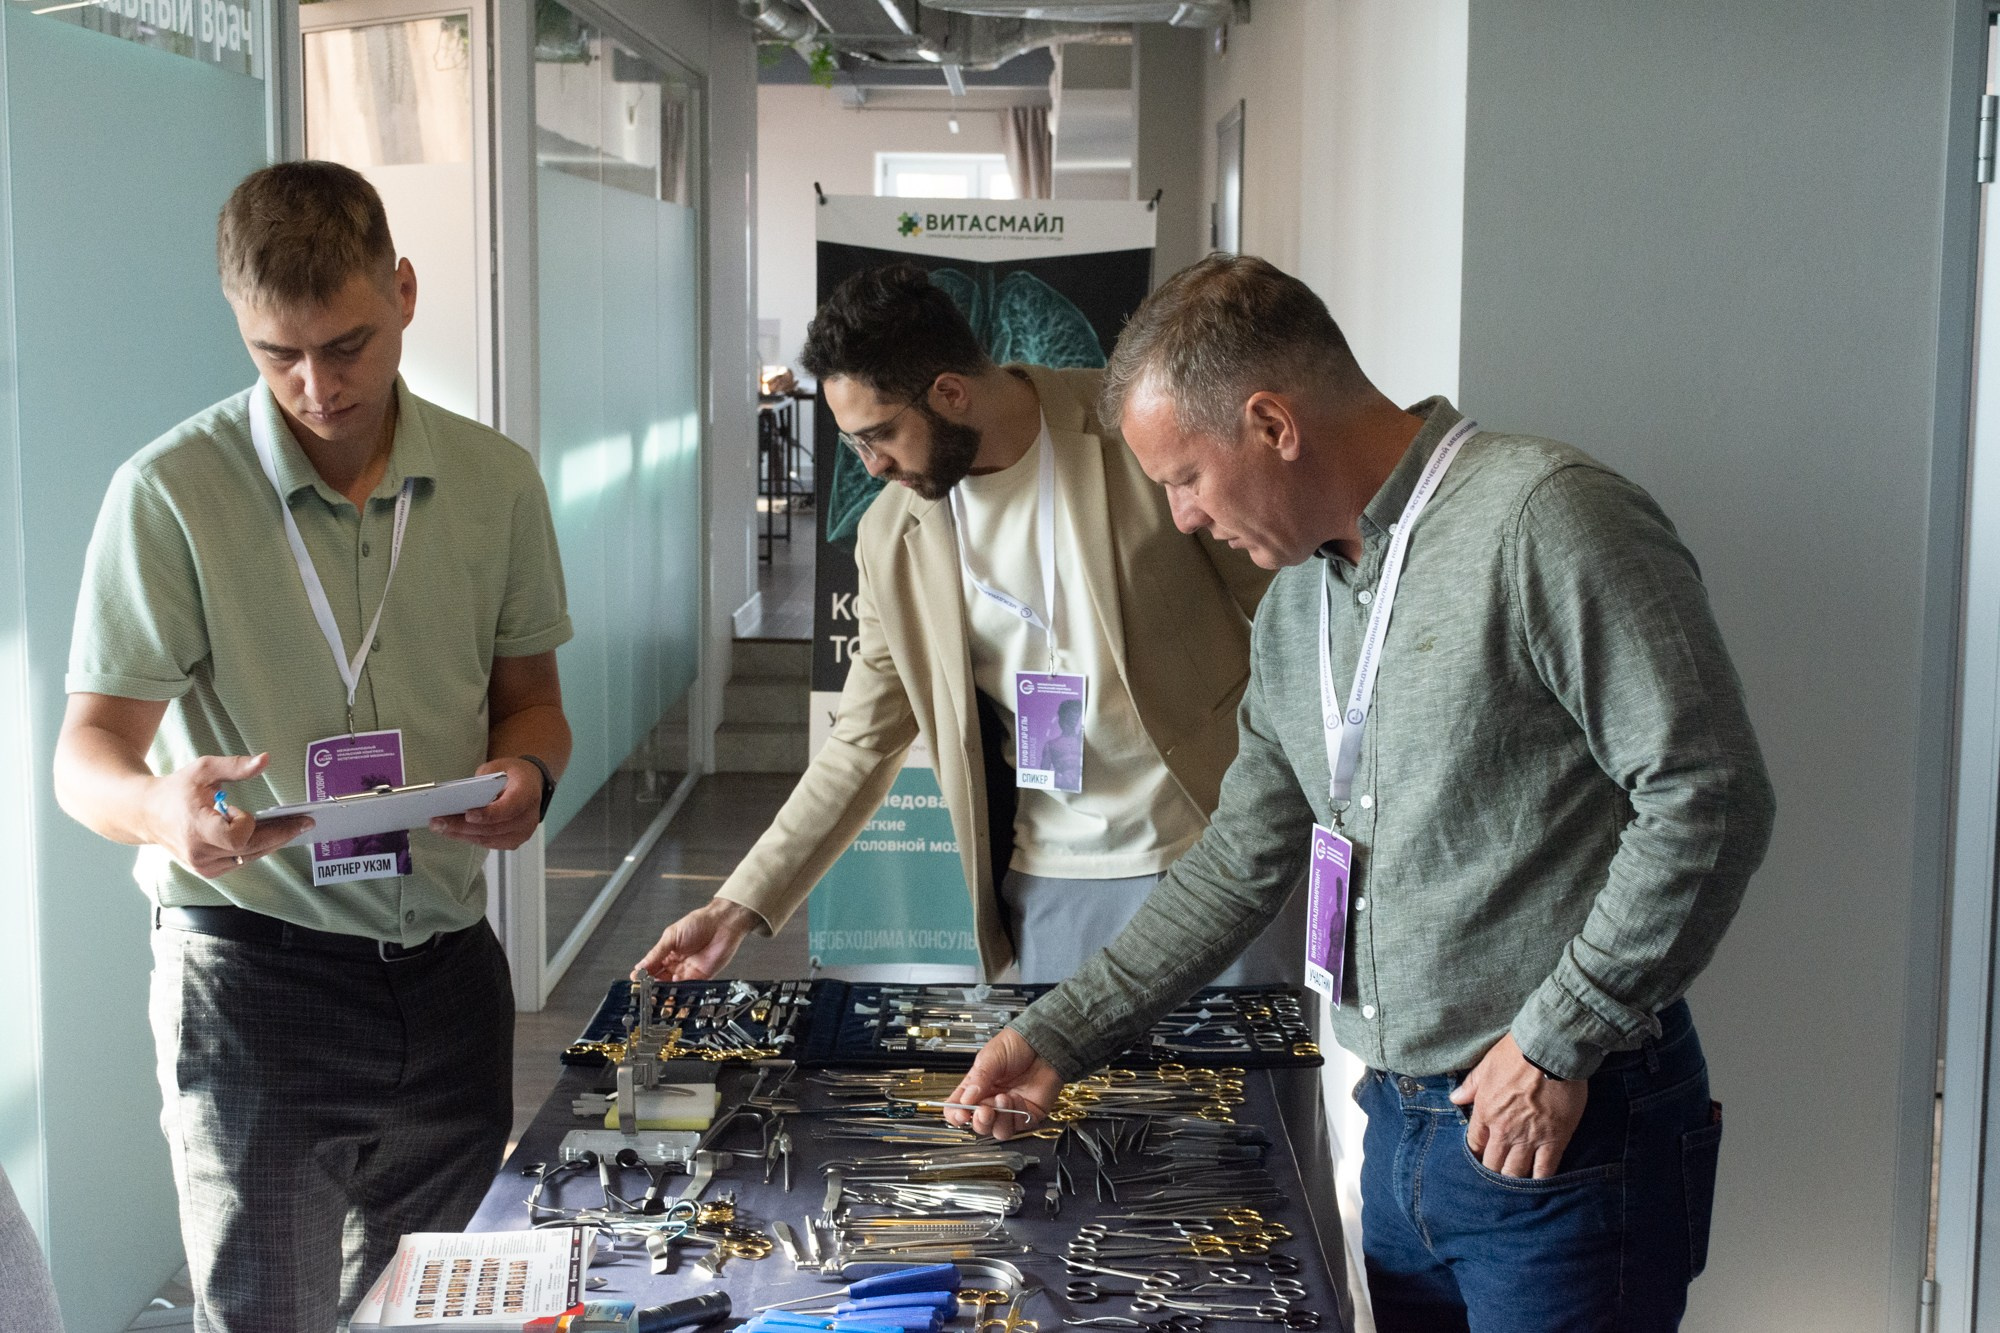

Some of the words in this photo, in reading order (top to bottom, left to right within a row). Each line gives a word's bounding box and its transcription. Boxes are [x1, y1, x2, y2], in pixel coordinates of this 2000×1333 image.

[201, 0, 252, 61] врач
[926, 212, 1064, 233] ВИТАСМАЙЛ
[1022, 773, 1048, 785] СПИКЕР
[853, 838, 926, 852] головной
[318, 862, 361, 879] ПАРТНЕР
[363, 858, 391, 873] УКЭМ
[1312, 868, 1321, 930] ВЛАДИМИРОВИЧ
[808, 930, 905, 950] НЕОБХОДИМА
